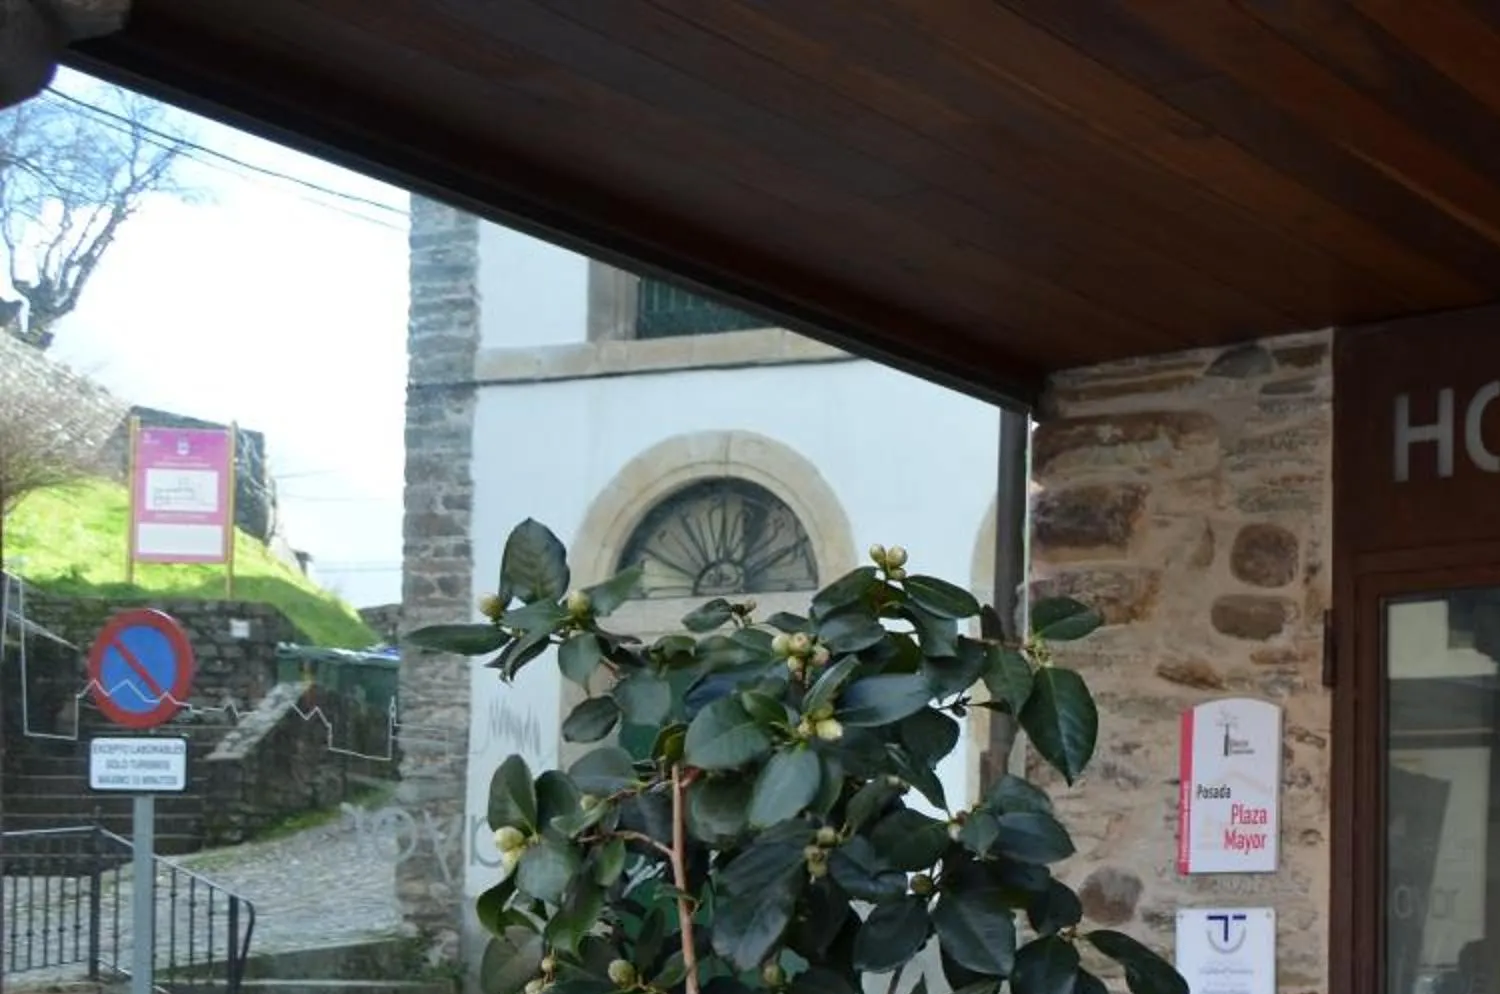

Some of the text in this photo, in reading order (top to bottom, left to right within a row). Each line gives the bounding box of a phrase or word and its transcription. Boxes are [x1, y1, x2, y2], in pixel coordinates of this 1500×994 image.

[1197, 784, 1232, 799] Posada
[1231, 803, 1268, 825] Plaza
[1223, 828, 1268, 855] Mayor
